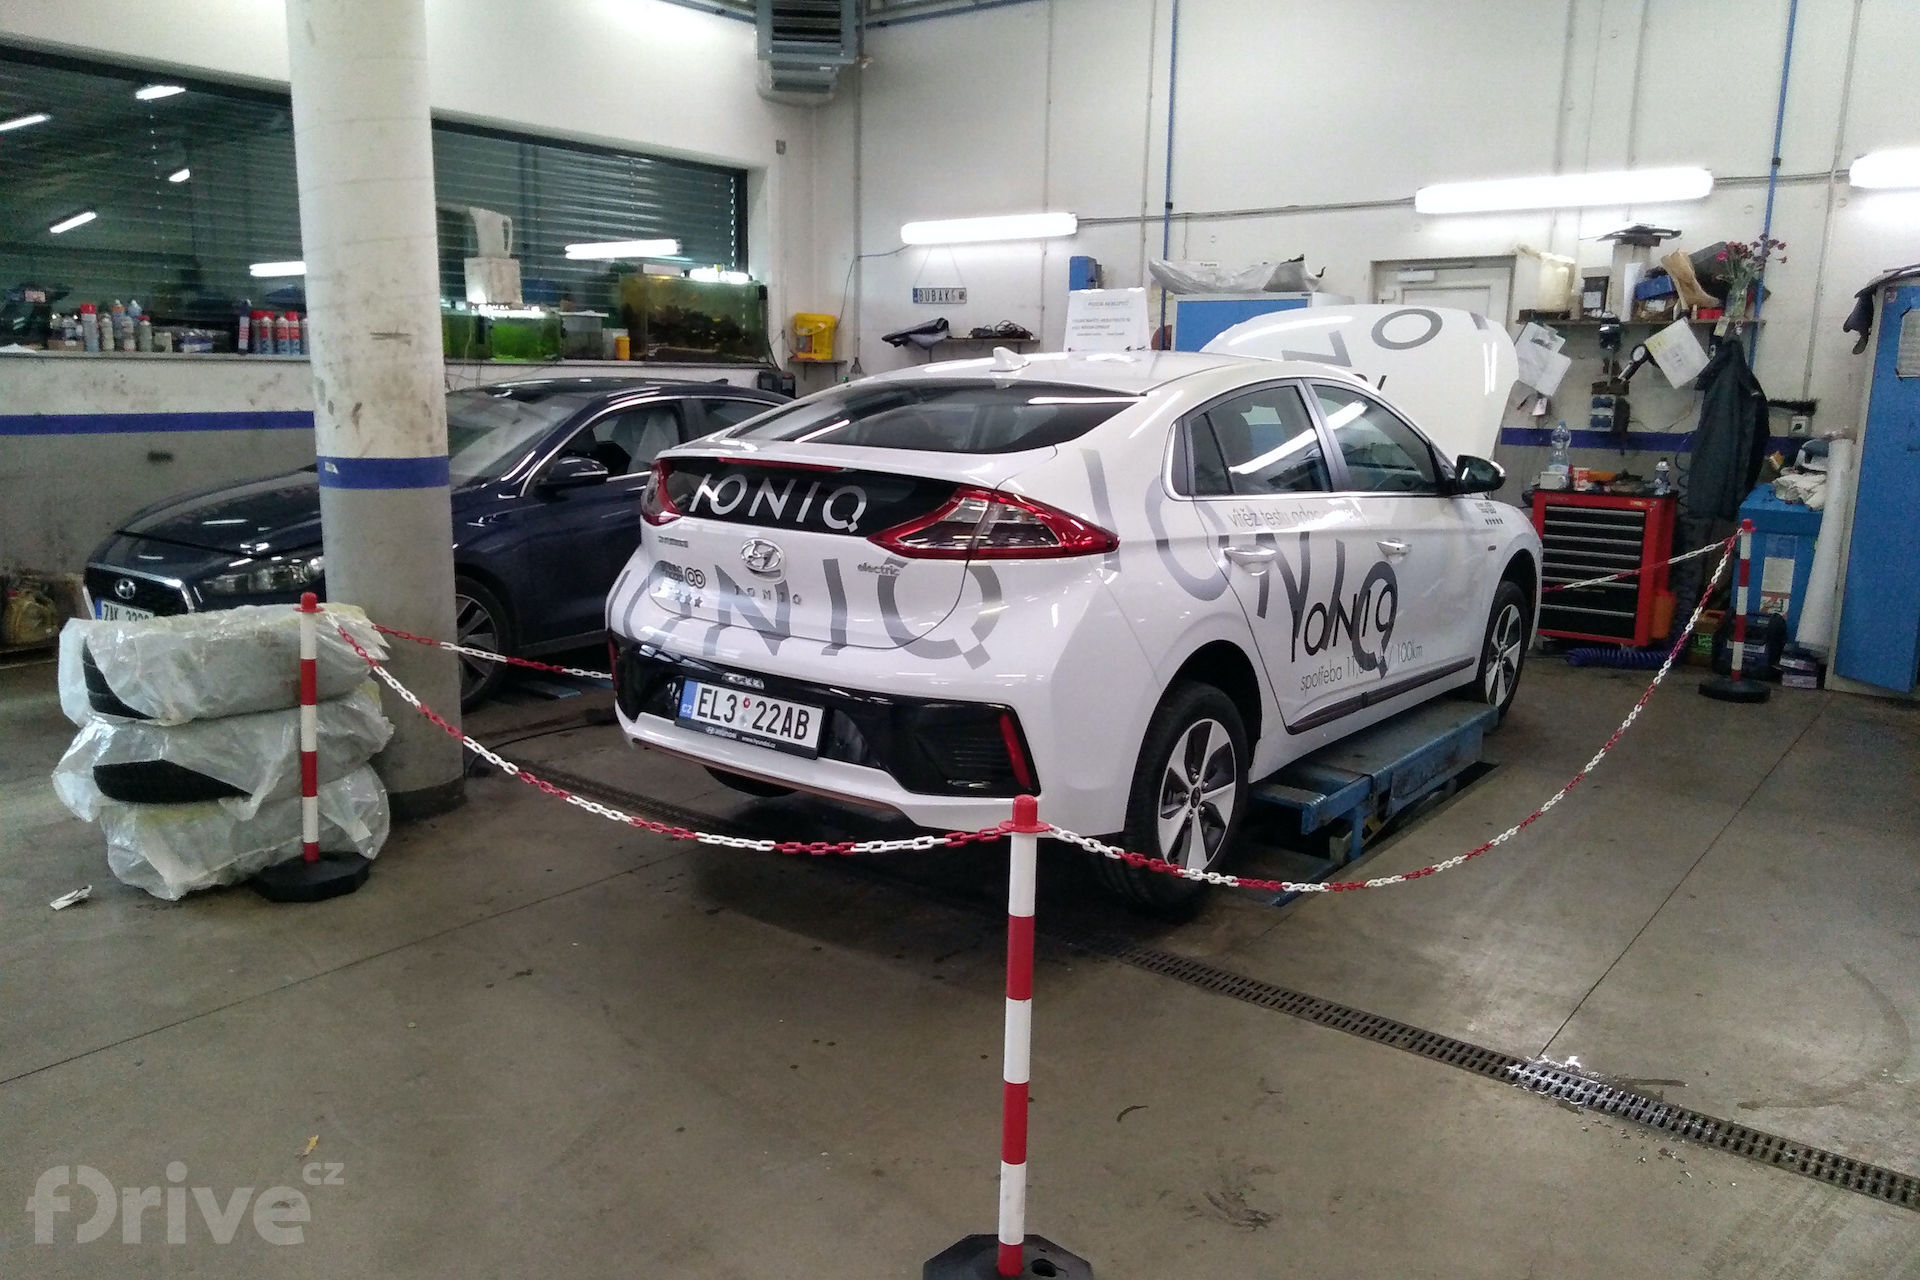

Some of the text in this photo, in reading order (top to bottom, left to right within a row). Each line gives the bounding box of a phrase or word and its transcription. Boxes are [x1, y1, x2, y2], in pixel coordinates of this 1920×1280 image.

[689, 473, 867, 533] IONIQ
[605, 556, 1001, 670] IONIQ
[734, 585, 802, 605] IONIQ
[1291, 584, 1394, 663] IONIQ
[1300, 660, 1342, 696] spotřeba
[1397, 641, 1423, 664] 100km
[680, 703, 692, 714] CZ
[697, 687, 810, 740] EL3 22AB
